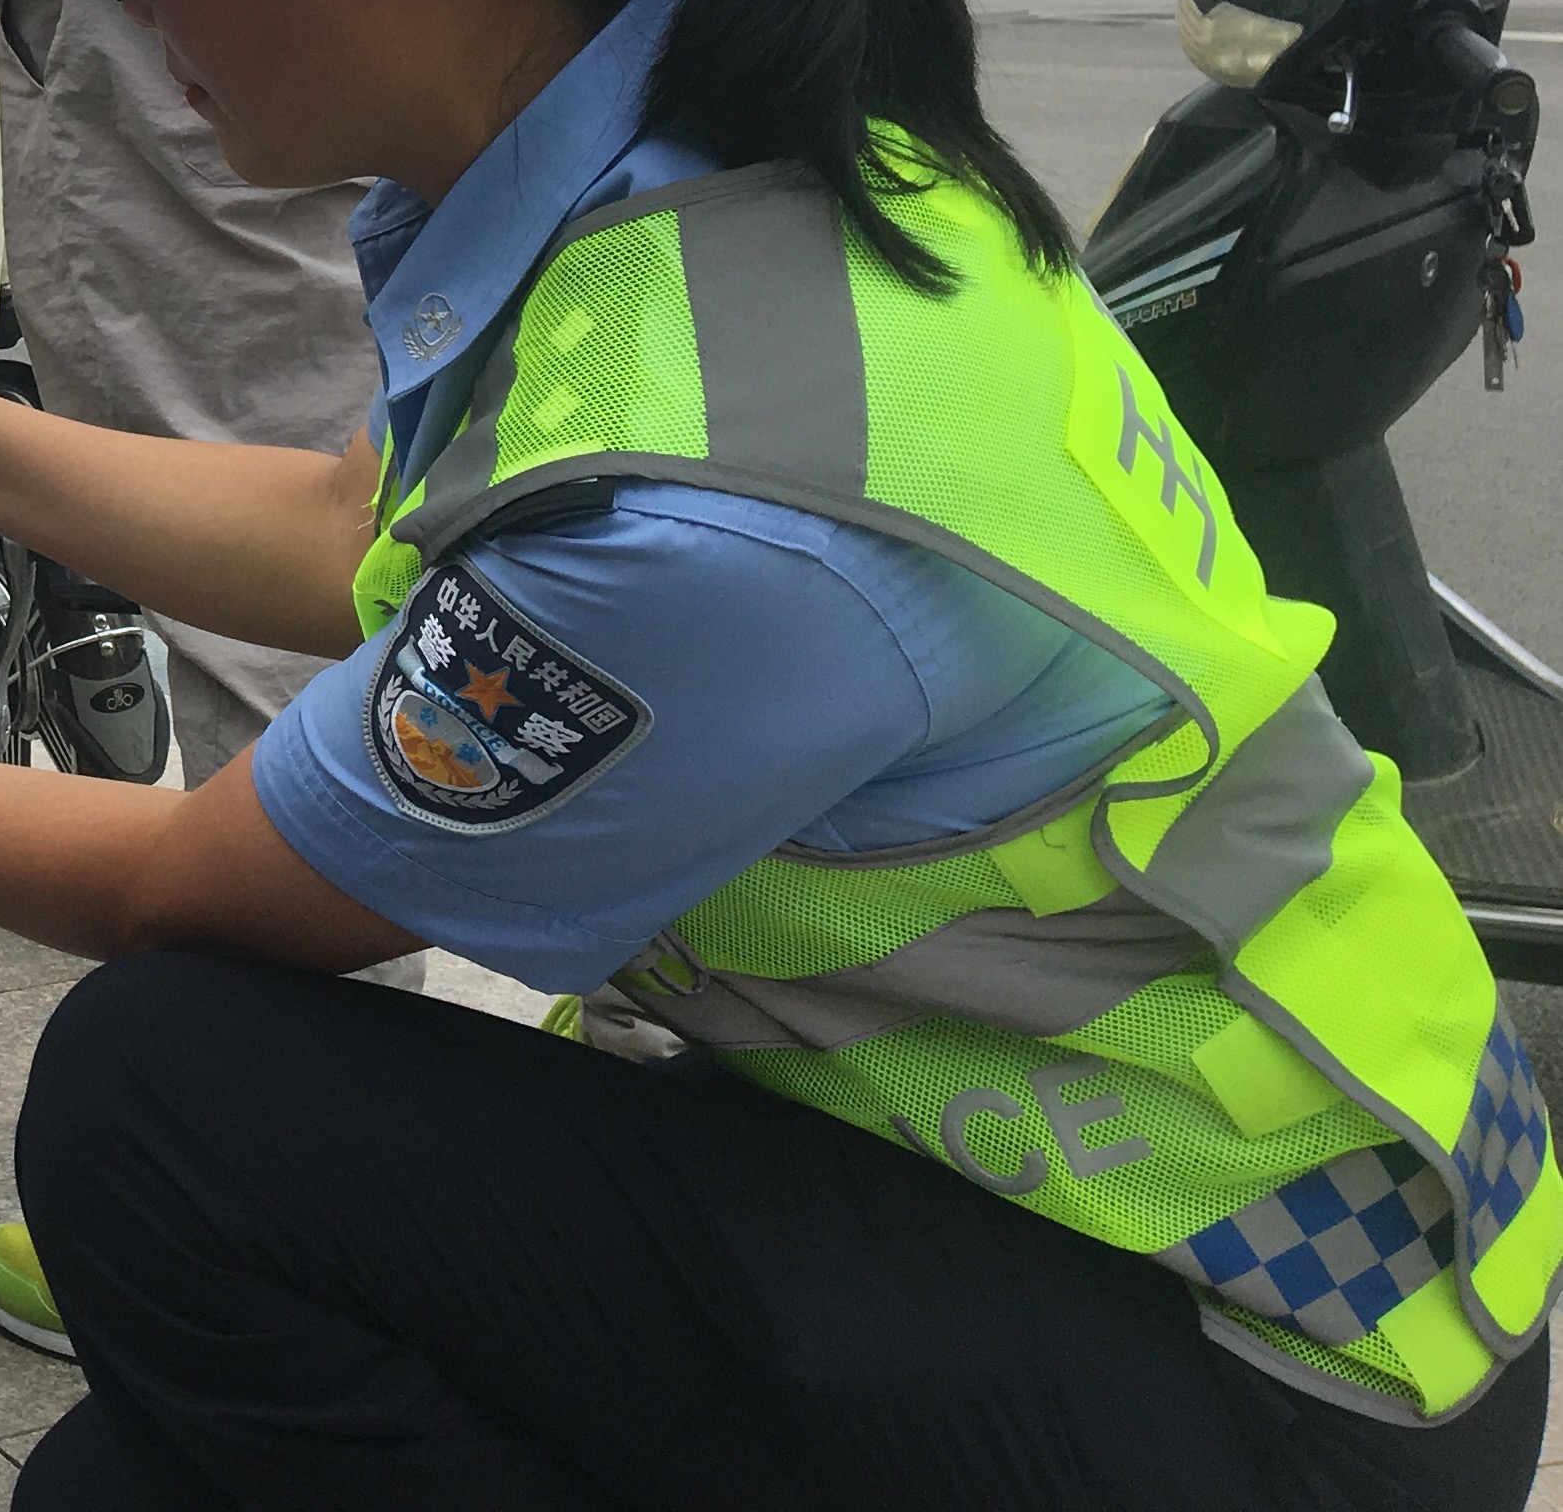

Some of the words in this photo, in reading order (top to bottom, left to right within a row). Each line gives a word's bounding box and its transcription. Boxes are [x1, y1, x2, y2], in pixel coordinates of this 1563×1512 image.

[417, 613, 456, 671] 警
[437, 576, 628, 735] 中华人民共和国
